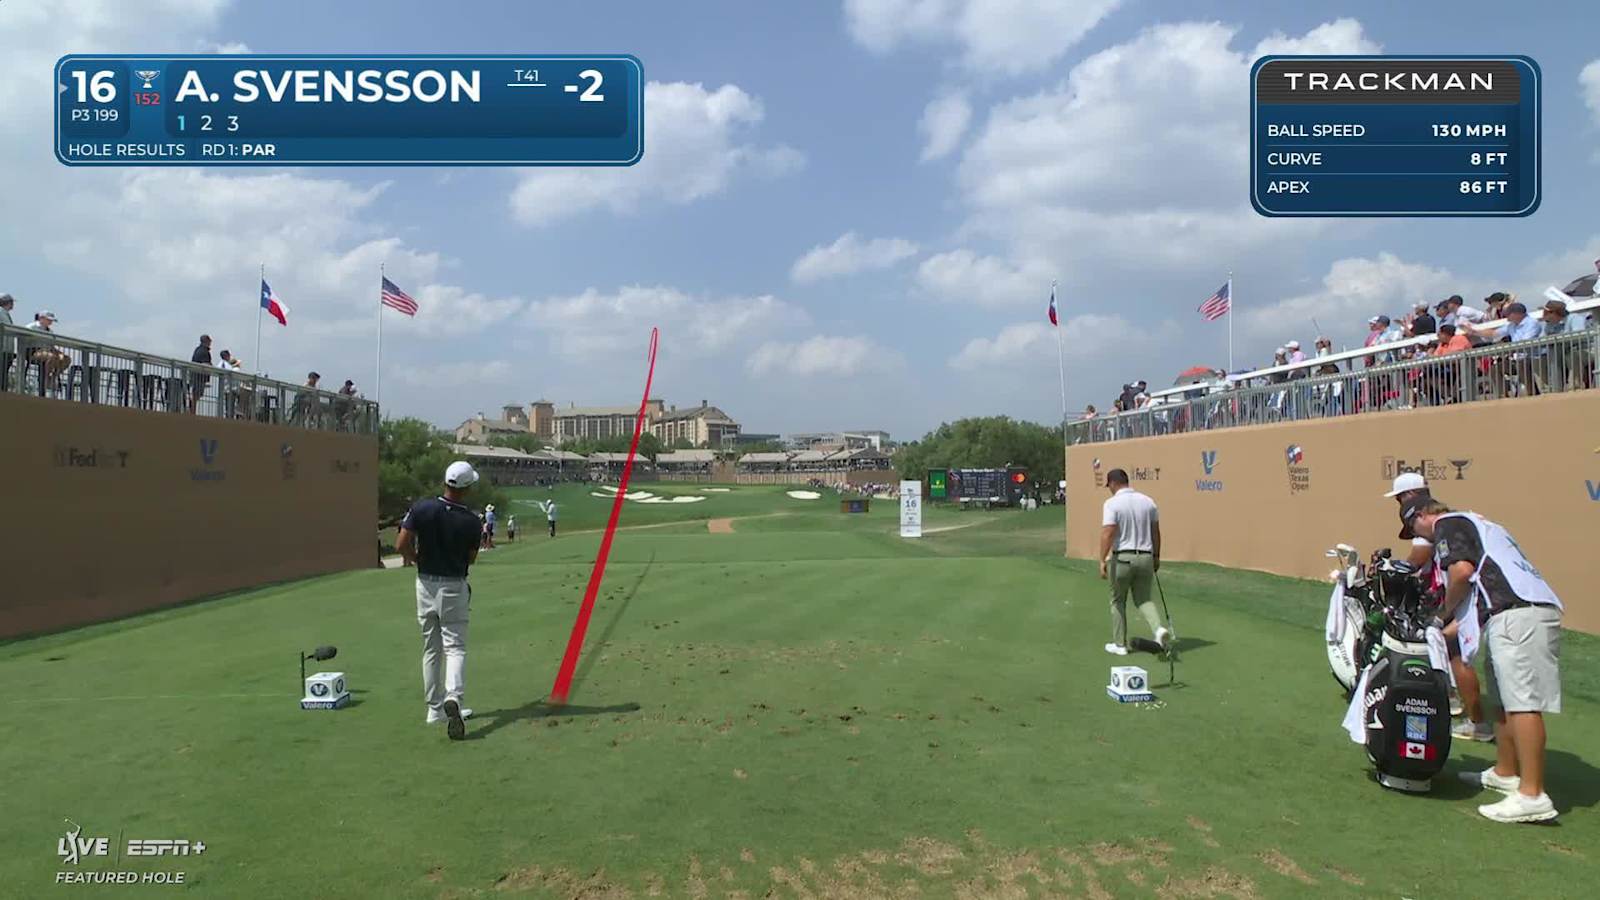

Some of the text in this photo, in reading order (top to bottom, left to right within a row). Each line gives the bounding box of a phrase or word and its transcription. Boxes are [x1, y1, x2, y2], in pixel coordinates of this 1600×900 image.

[69, 447, 116, 468] Fed
[1195, 480, 1223, 491] Valero
[905, 499, 917, 508] 16
[1405, 698, 1429, 707] ADAM
[1395, 703, 1437, 716] SVENSSON
